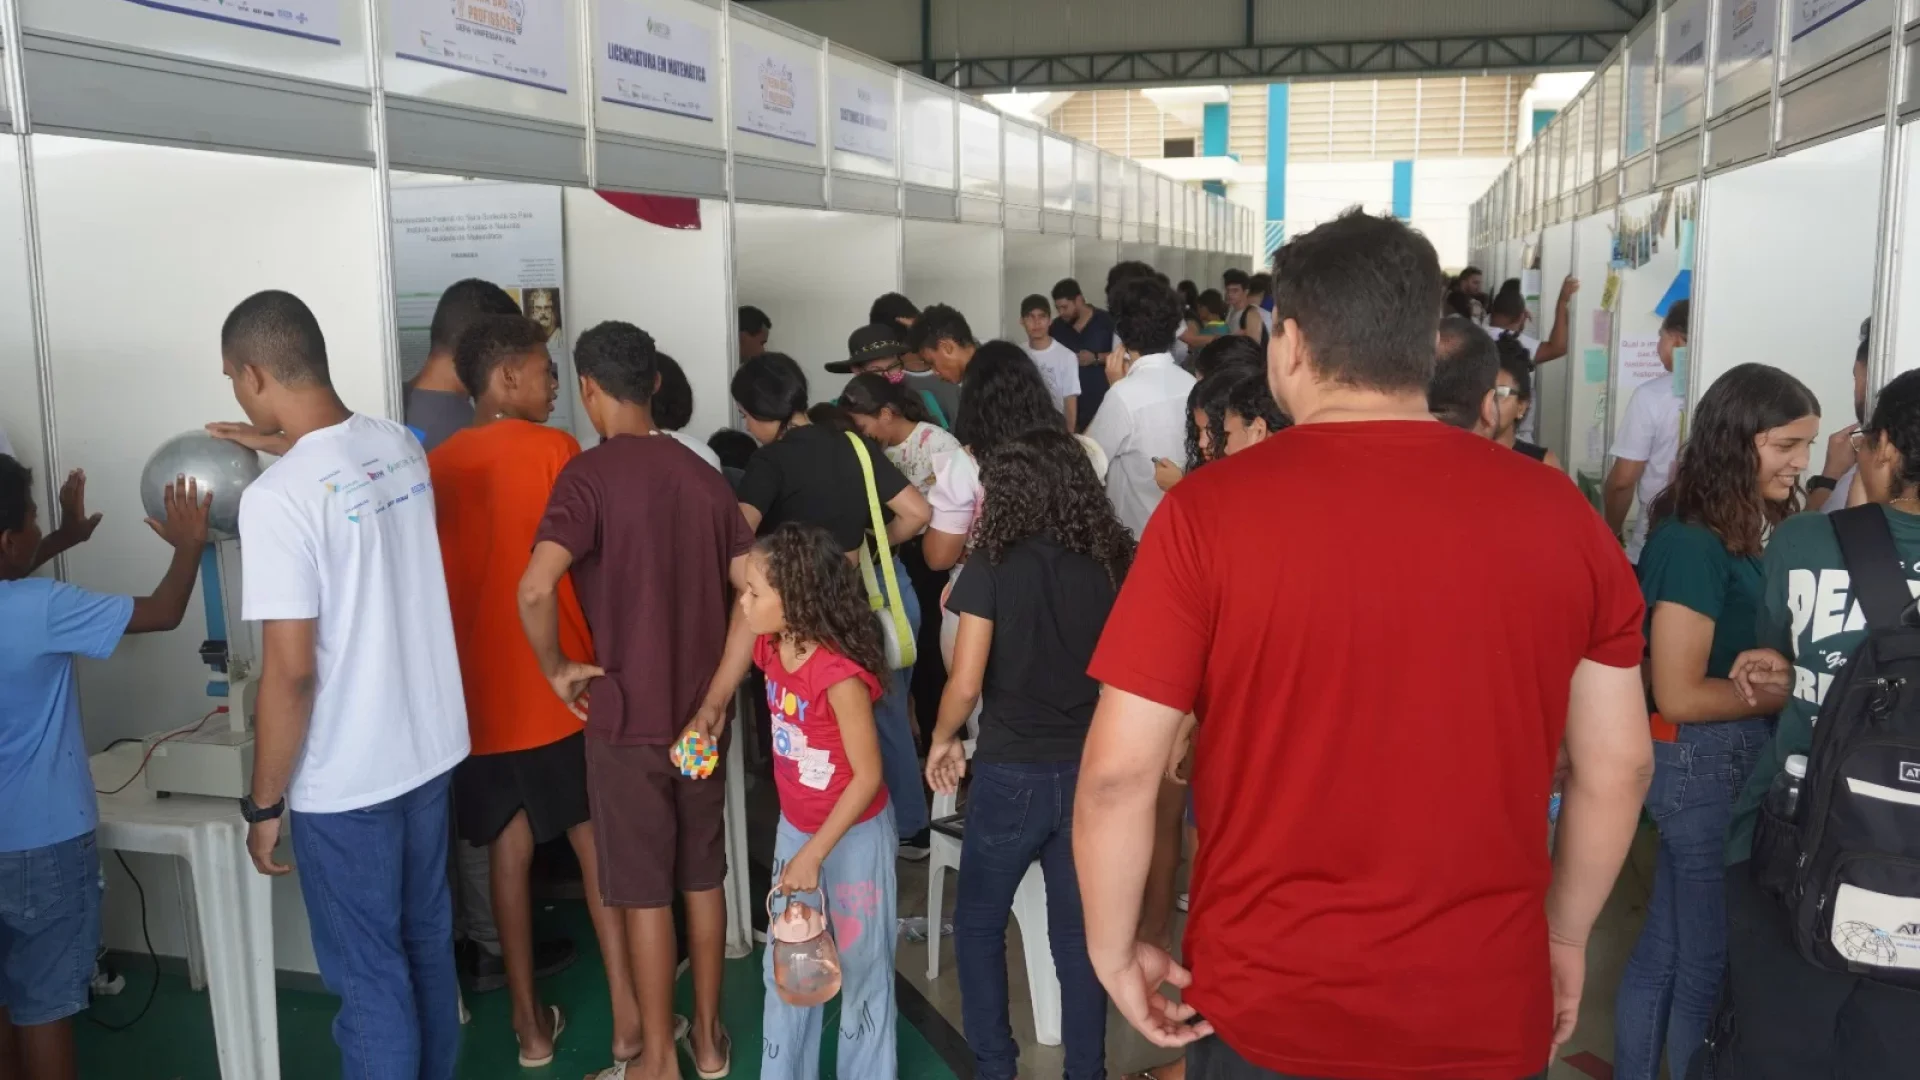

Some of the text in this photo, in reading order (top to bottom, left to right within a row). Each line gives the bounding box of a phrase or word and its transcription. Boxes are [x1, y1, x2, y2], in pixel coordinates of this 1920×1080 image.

[607, 42, 706, 82] LICENCIATURA EM MATEMÁTICA
[764, 674, 809, 721] NJOY
